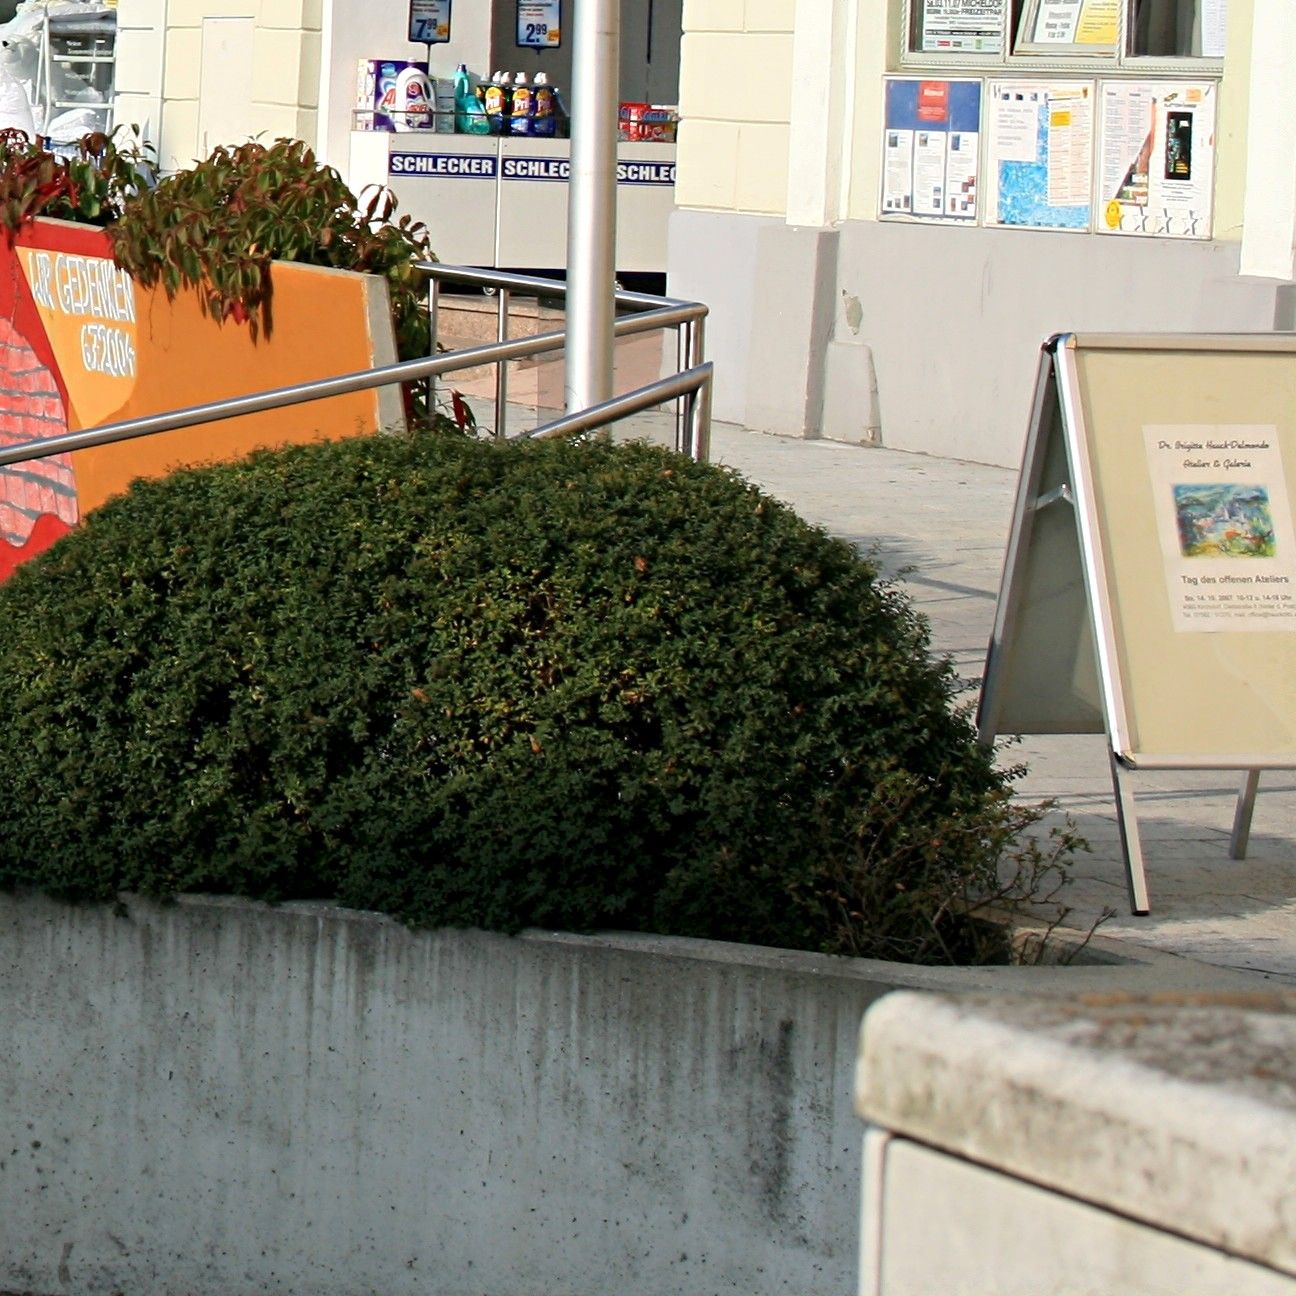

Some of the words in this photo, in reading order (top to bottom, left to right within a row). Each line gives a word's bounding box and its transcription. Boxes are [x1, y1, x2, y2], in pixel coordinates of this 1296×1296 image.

[391, 155, 493, 175] SCHLECKER
[1181, 575, 1198, 586] Tag
[1200, 575, 1216, 584] des
[1219, 575, 1253, 584] offenen
[1255, 574, 1290, 584] Ateliers
